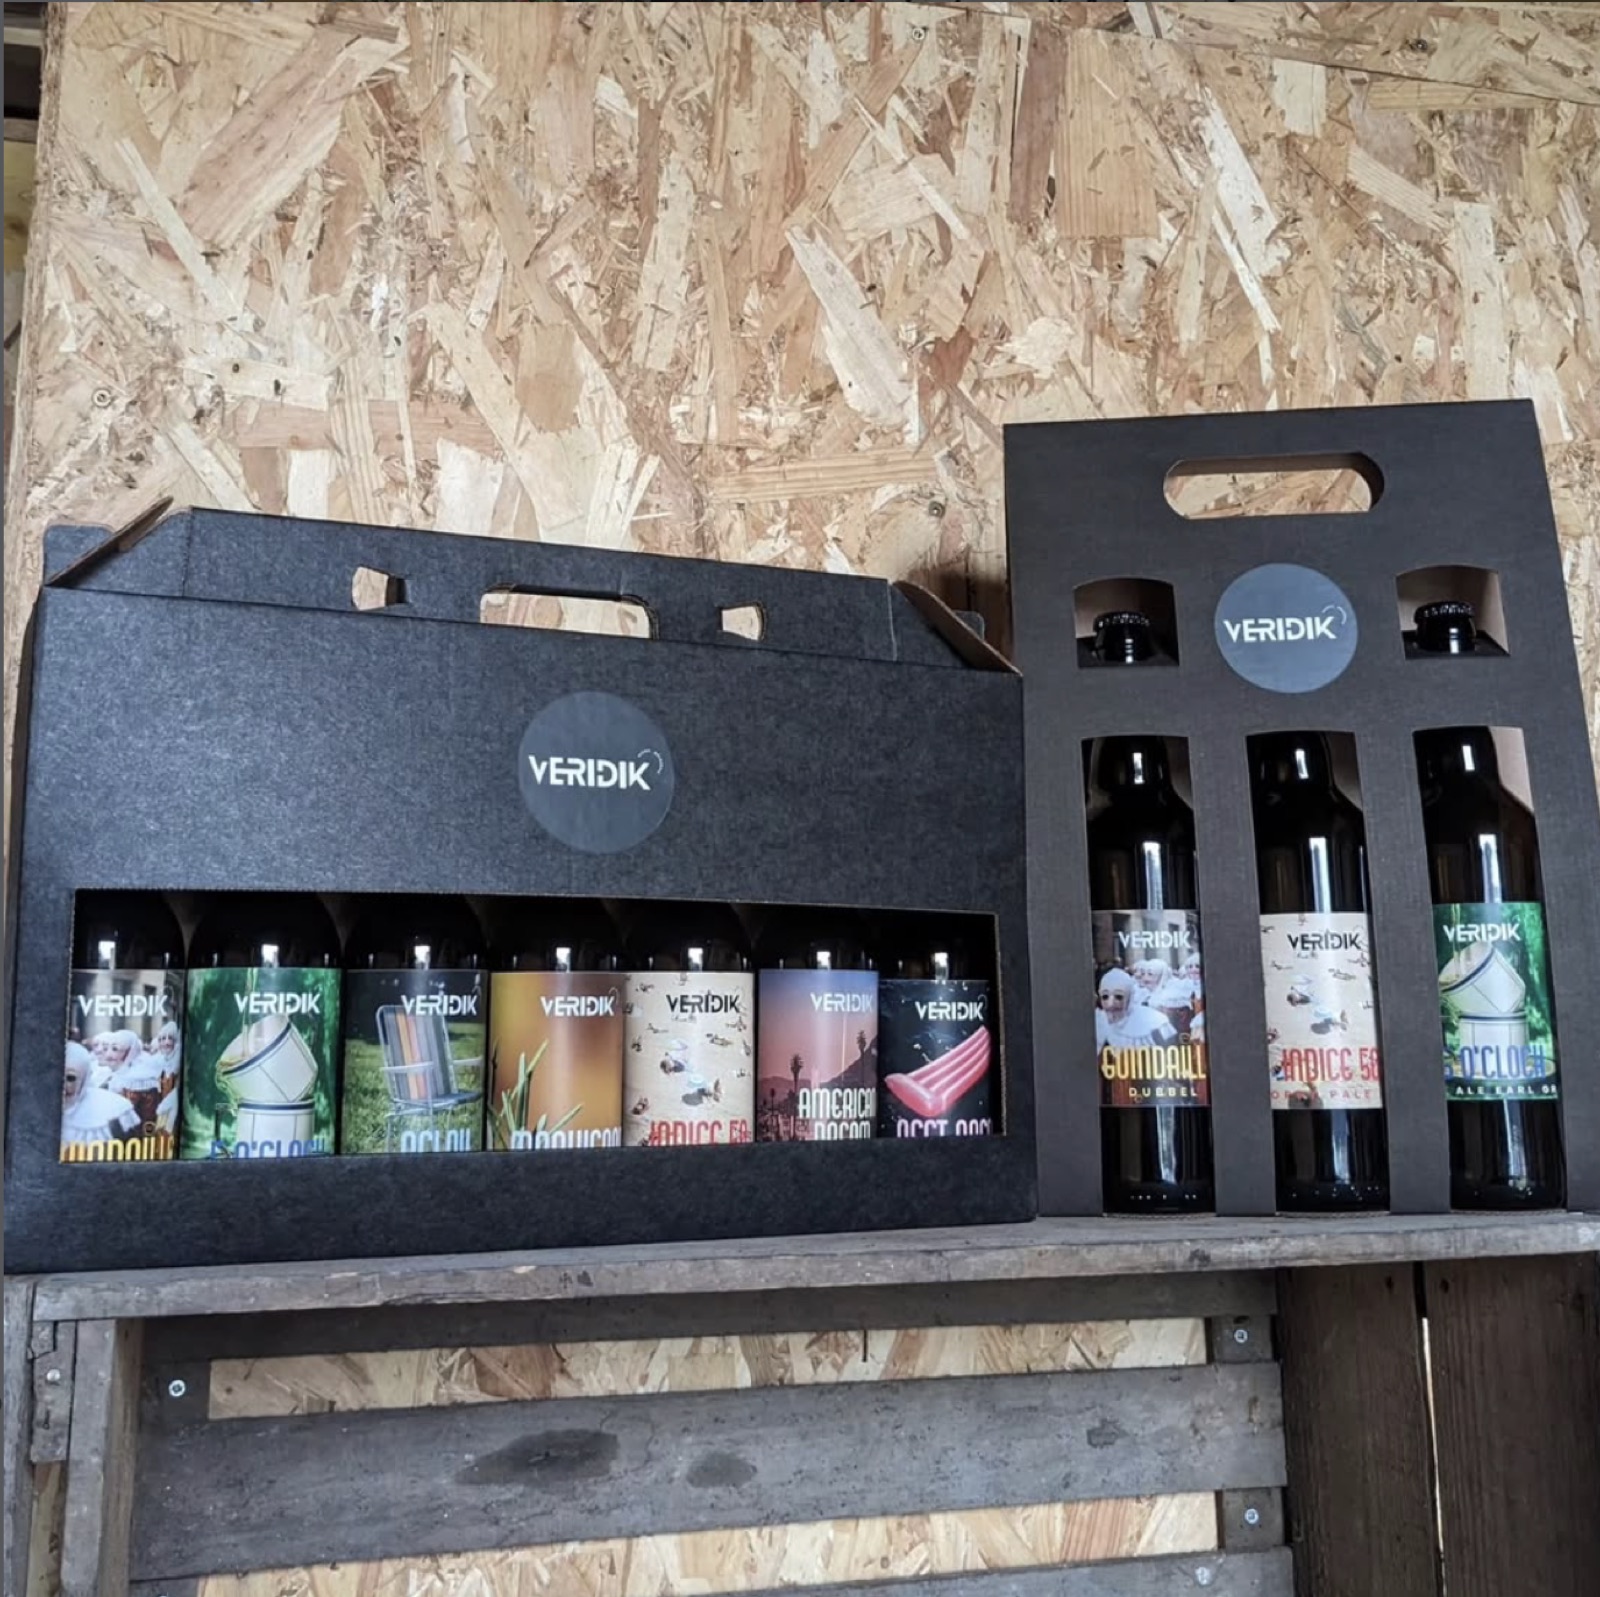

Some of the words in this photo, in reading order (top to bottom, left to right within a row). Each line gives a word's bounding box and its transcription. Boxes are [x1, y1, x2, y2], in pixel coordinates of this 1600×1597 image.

[1223, 616, 1337, 643] VERIDIK
[528, 755, 651, 790] VERIDIK
[1118, 930, 1191, 949] VERIDIK
[1287, 932, 1362, 951] VERIDIK
[1443, 923, 1521, 942] VERIDIK
[77, 994, 168, 1017] VERIDIK
[234, 992, 321, 1014] VERIDIK
[401, 994, 477, 1016] VERIDIK
[540, 995, 615, 1017] VERIDIK
[666, 993, 741, 1014] VERIDIK
[810, 992, 873, 1012] VERIDIK
[914, 1001, 984, 1021] VERIDIK
[1128, 1086, 1198, 1098] DUBBEL
